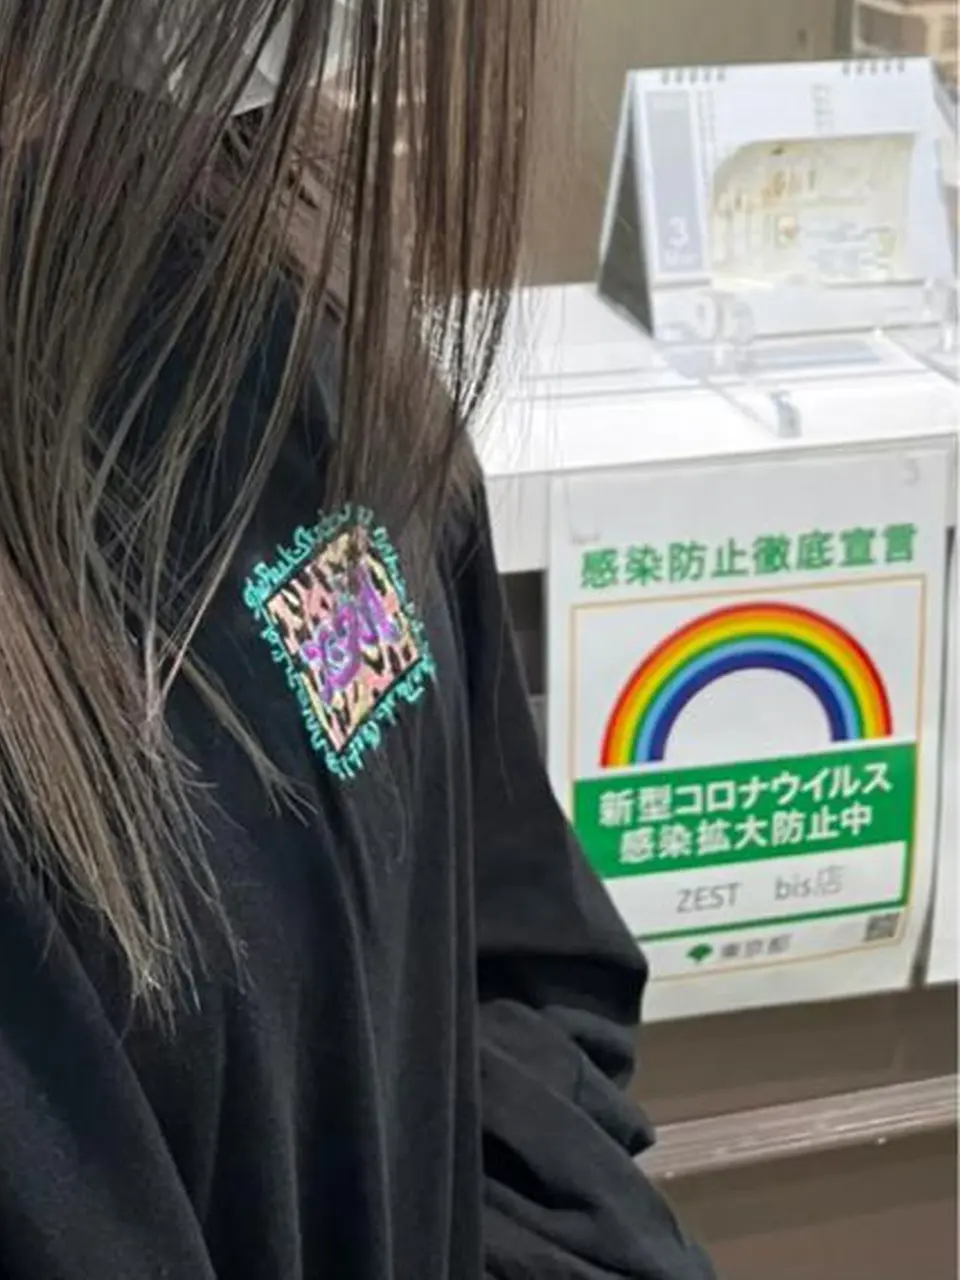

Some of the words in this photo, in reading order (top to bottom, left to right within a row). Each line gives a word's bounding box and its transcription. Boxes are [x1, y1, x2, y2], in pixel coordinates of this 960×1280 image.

[581, 522, 917, 589] 感染防止徹底宣言
[598, 762, 893, 828] 新型コロナウイルス
[619, 801, 874, 864] 感染拡大防止中
[676, 881, 742, 914] ZEST
